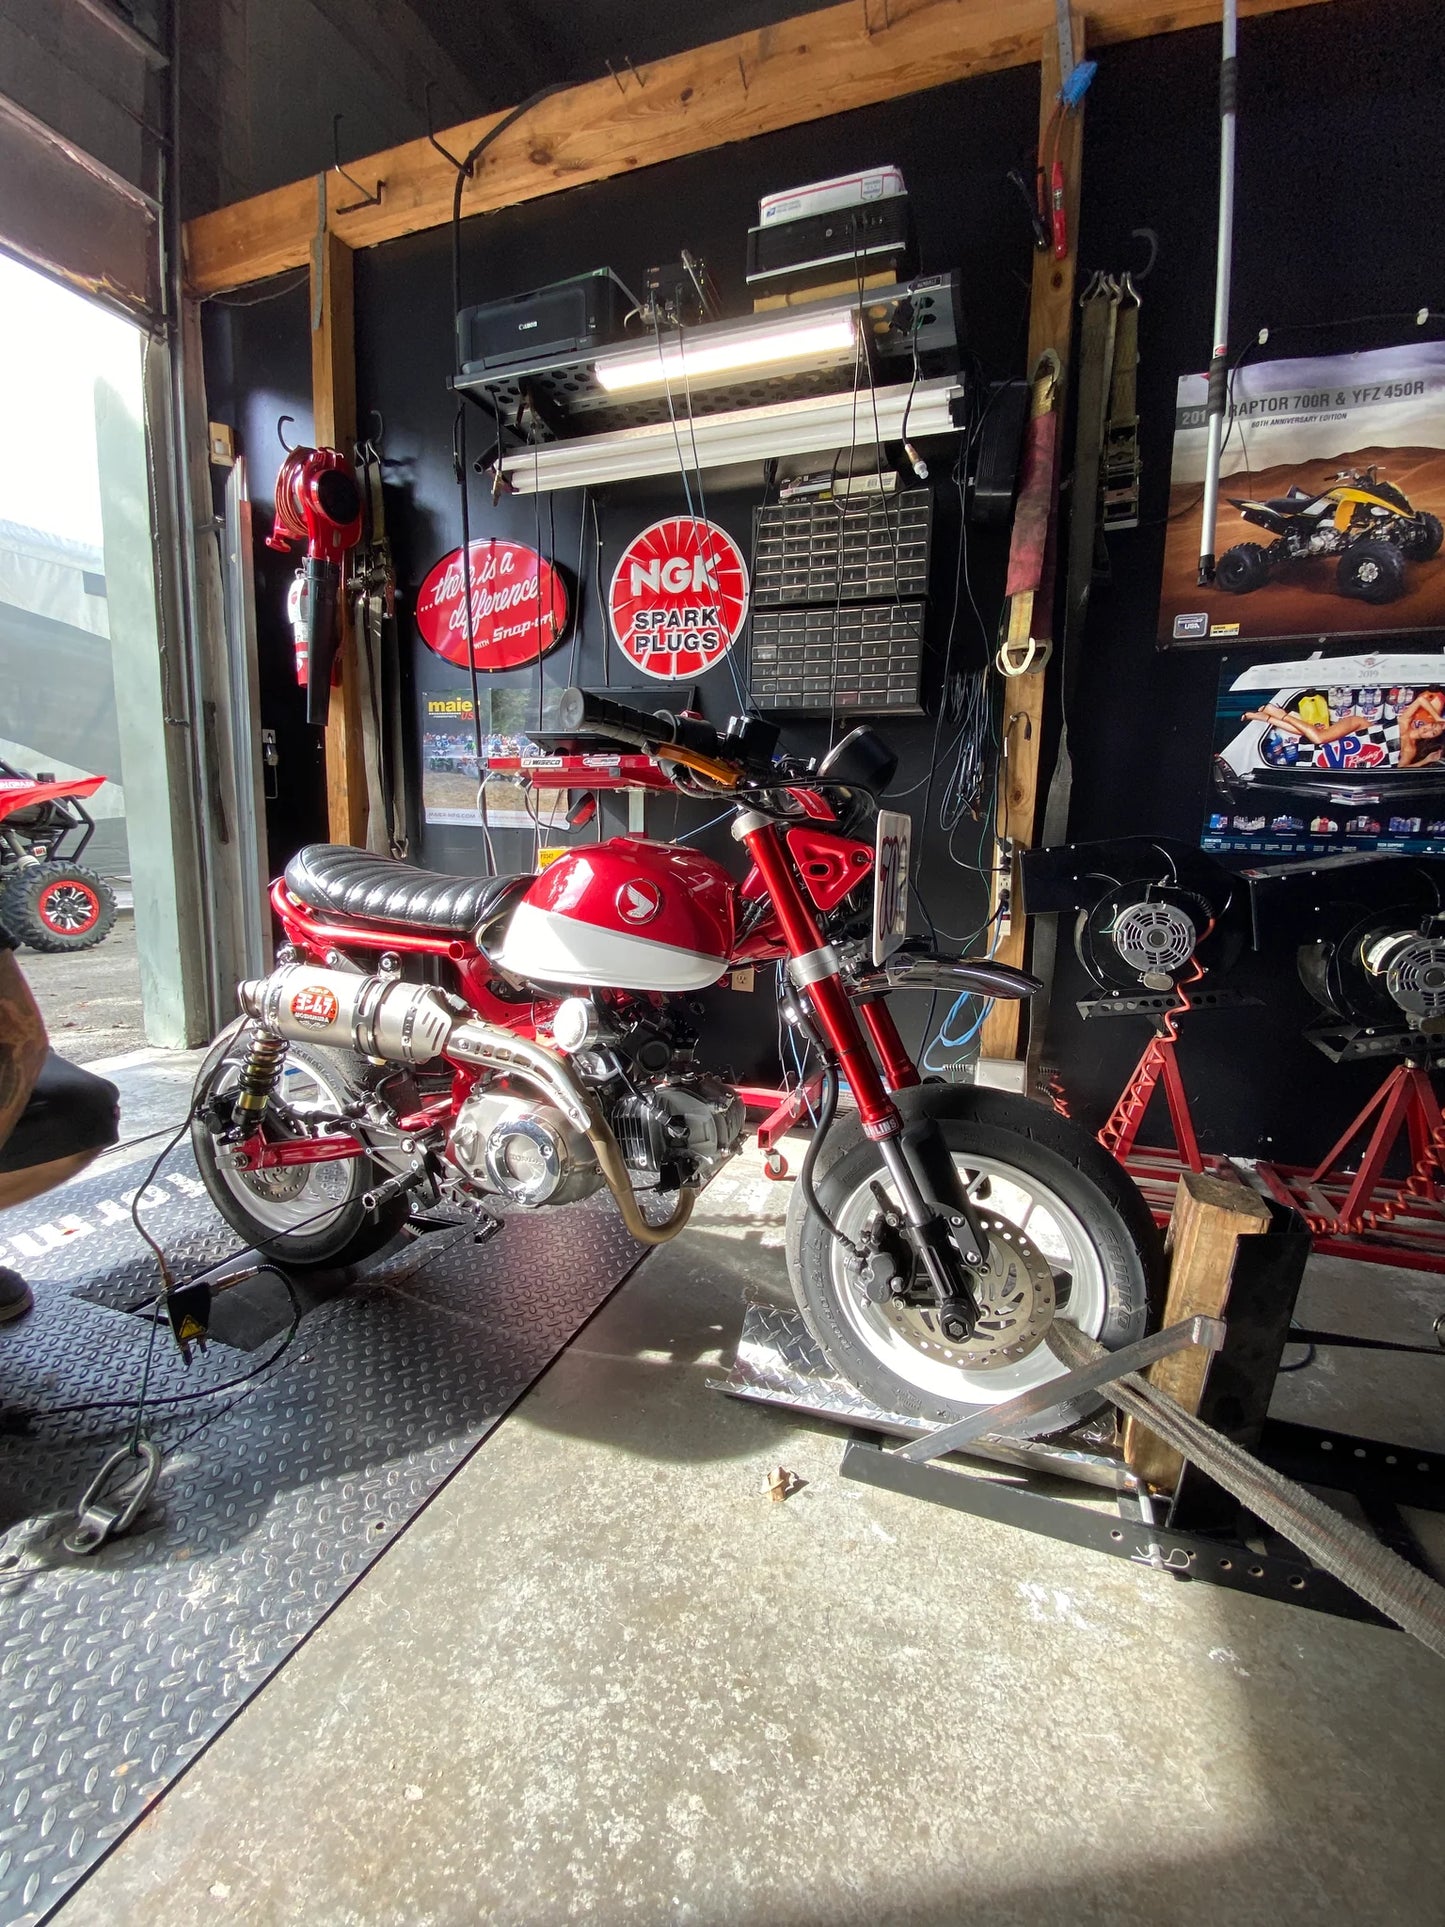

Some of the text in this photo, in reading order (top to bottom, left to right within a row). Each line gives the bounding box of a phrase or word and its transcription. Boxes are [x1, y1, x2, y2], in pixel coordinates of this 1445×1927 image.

[518, 321, 538, 331] Canon
[1182, 380, 1425, 426] 201 RAPTOR 700R & YFZ 450R
[1270, 415, 1317, 426] ANNIVERSARY
[1319, 412, 1348, 423] EDITION
[477, 554, 497, 586] is
[500, 552, 515, 575] a
[631, 552, 722, 597] NGK
[634, 606, 720, 632] SPARK
[634, 632, 720, 655] PLUGS
[428, 696, 480, 713] maie
[461, 711, 475, 721] US
[1322, 736, 1362, 769] VP
[1103, 1227, 1132, 1331] SHINKO
